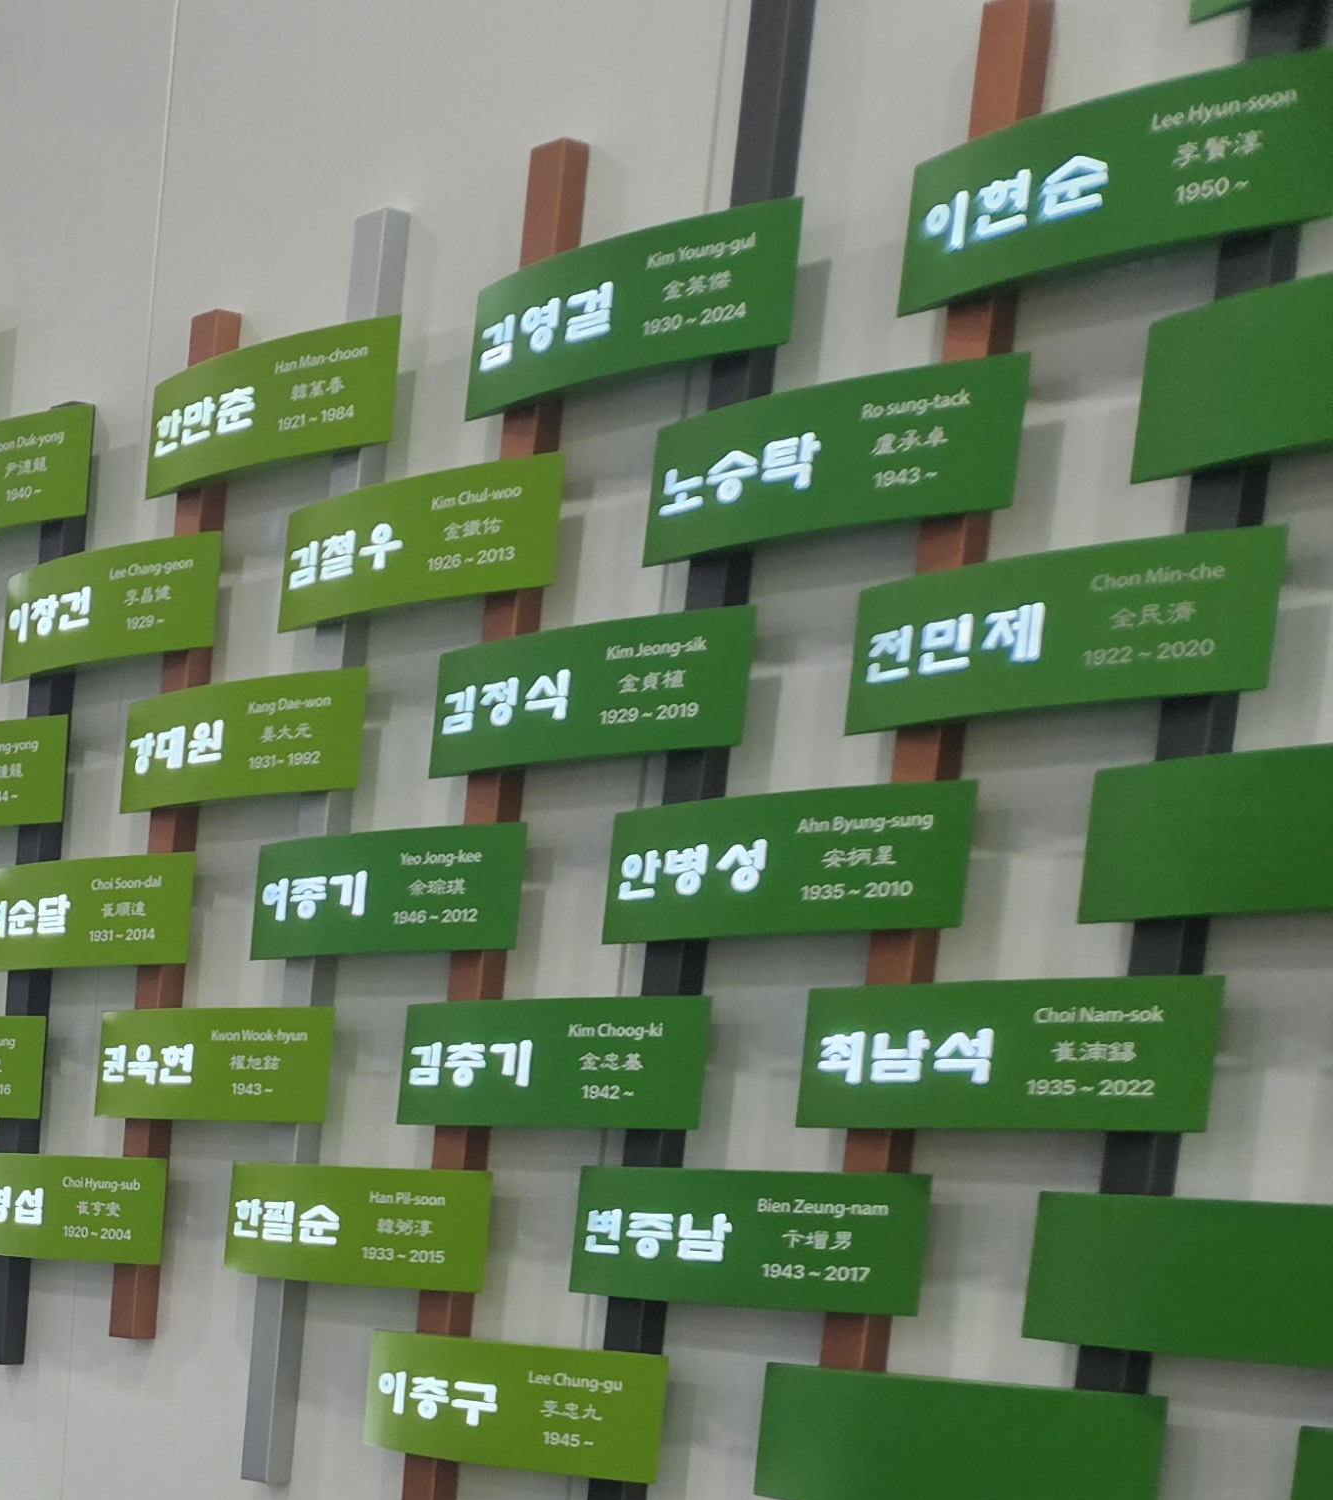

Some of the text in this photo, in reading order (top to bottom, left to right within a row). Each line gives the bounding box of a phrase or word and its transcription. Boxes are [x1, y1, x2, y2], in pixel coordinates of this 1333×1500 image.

[1151, 88, 1297, 131] Lee Hyun-soon
[1175, 176, 1229, 203] 1950
[923, 154, 1109, 250] 이현순
[646, 233, 756, 271] Kim Young-gul
[479, 281, 614, 372] 김영걸
[642, 302, 746, 336] 1930 2024
[274, 345, 368, 375] Han Man-choon
[860, 388, 971, 421] Ro sung-tack
[154, 386, 255, 458] 한만춘
[278, 405, 354, 432] 1921 1984
[17, 431, 64, 450] Duk-yong
[658, 431, 821, 516] 노승탁
[872, 467, 921, 488] 1943
[6, 487, 31, 502] 1940
[431, 485, 522, 512] Kim Chul-woo
[289, 522, 403, 590] 김철우
[428, 546, 515, 571] 1926 2013
[109, 557, 193, 581] Lee Chang-geon
[1091, 562, 1225, 592] Chon Min-che
[9, 586, 91, 643] 이창건
[125, 615, 153, 631] 1929
[606, 636, 707, 660] Kim Jeong-sik
[866, 602, 1046, 684] 전민제
[1083, 639, 1215, 667] 1922 2020
[248, 695, 331, 715] Kang Dae-won
[442, 669, 571, 735] 김정식
[600, 702, 699, 725] 1929 2019
[130, 719, 224, 775] 강대원
[288, 751, 321, 766] 1992
[796, 813, 934, 834] Ahn Byung-sung
[400, 849, 482, 867] Yeo Jong-kee
[618, 838, 767, 900] 안병성
[91, 875, 162, 891] Choi Soon-dal
[800, 881, 913, 901] 1935 2010
[262, 870, 367, 922] 여종기
[392, 908, 477, 925] 1946 2012
[89, 928, 155, 942] 1931 2014
[1035, 1006, 1164, 1024] Choi Nam-sok
[211, 1028, 308, 1044] Kwon Wook-hyun
[568, 1022, 663, 1041] Kim Choog-ki
[102, 1043, 194, 1086] 권욱현
[409, 1039, 533, 1087] 김충기
[817, 1027, 994, 1085] 최남석
[231, 1082, 262, 1096] 1943
[581, 1085, 620, 1100] 1942
[1026, 1079, 1155, 1097] 1935 2022
[62, 1177, 141, 1192] Choi Hyung-sub
[369, 1191, 445, 1207] Han Pil-soon
[757, 1198, 889, 1218] Bien Zeung-nam
[63, 1225, 132, 1241] 1920 2004
[233, 1198, 340, 1246] 한필순
[585, 1208, 733, 1262] 변증남
[361, 1246, 445, 1264] 1933 2015
[761, 1263, 871, 1282] 1943 2017
[528, 1370, 623, 1393] Lee Chung-gu
[378, 1370, 498, 1427] 이충구
[542, 1430, 580, 1448] 1945
